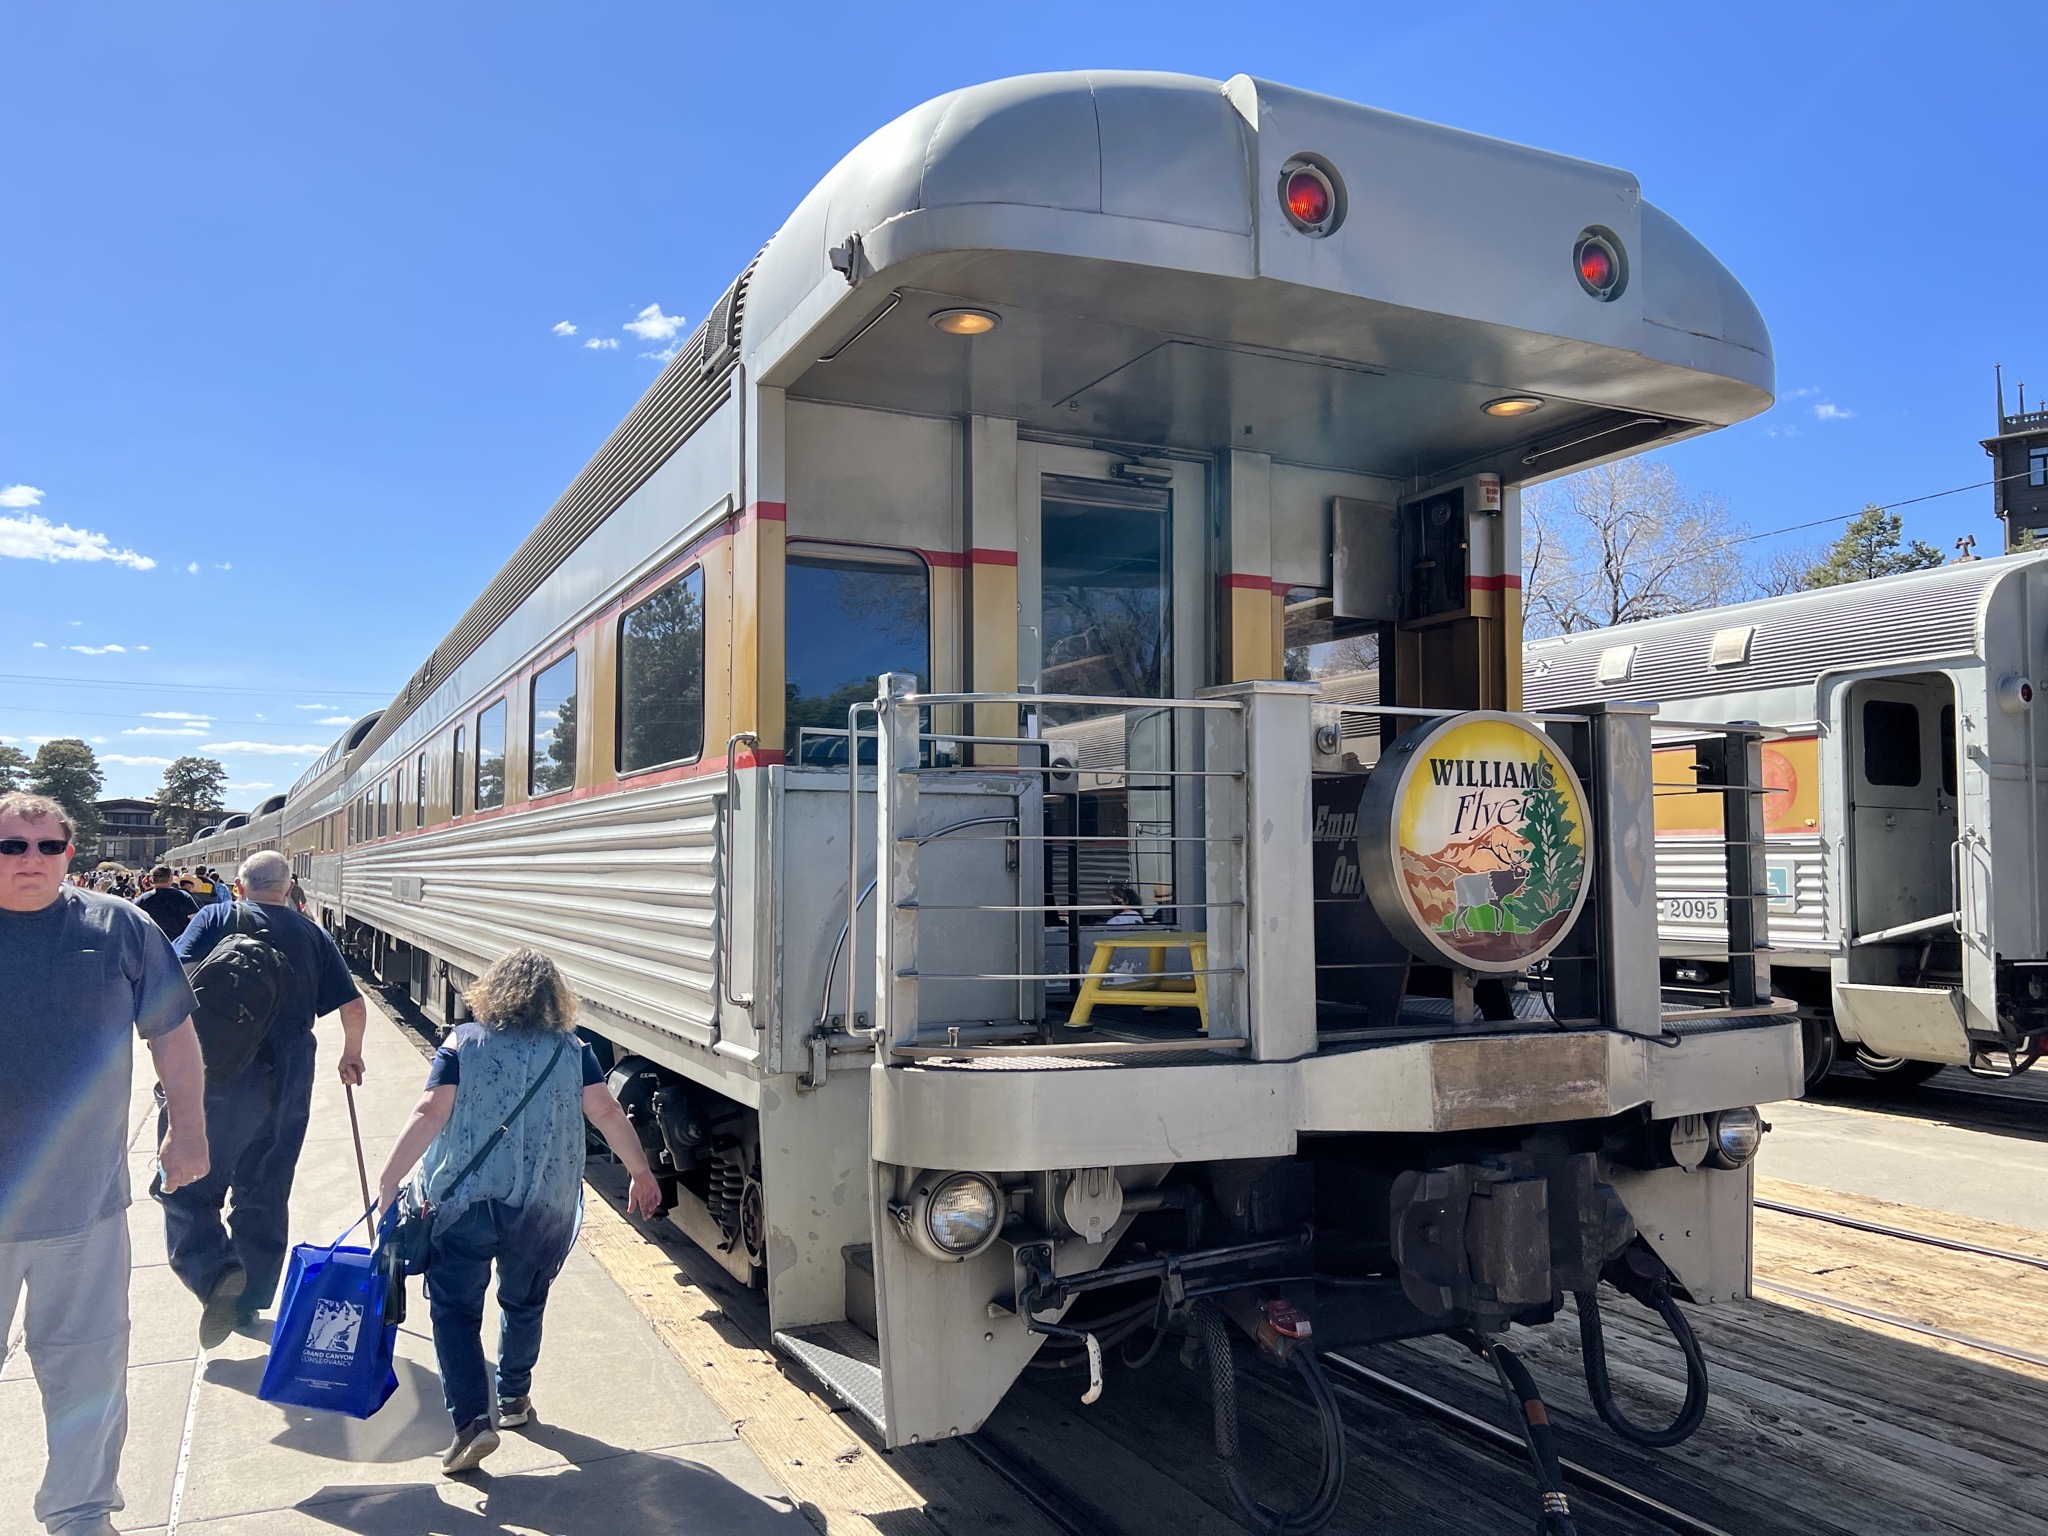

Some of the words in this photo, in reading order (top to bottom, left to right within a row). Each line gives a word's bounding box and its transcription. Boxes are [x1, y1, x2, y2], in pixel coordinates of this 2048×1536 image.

[1429, 758, 1554, 790] WILLIAMS
[1451, 789, 1536, 841] Flyer
[1671, 900, 1717, 919] 2095
[301, 1356, 352, 1367] CONSERVANCY
[303, 1349, 324, 1358] GRAND
[325, 1352, 354, 1361] CANYON
